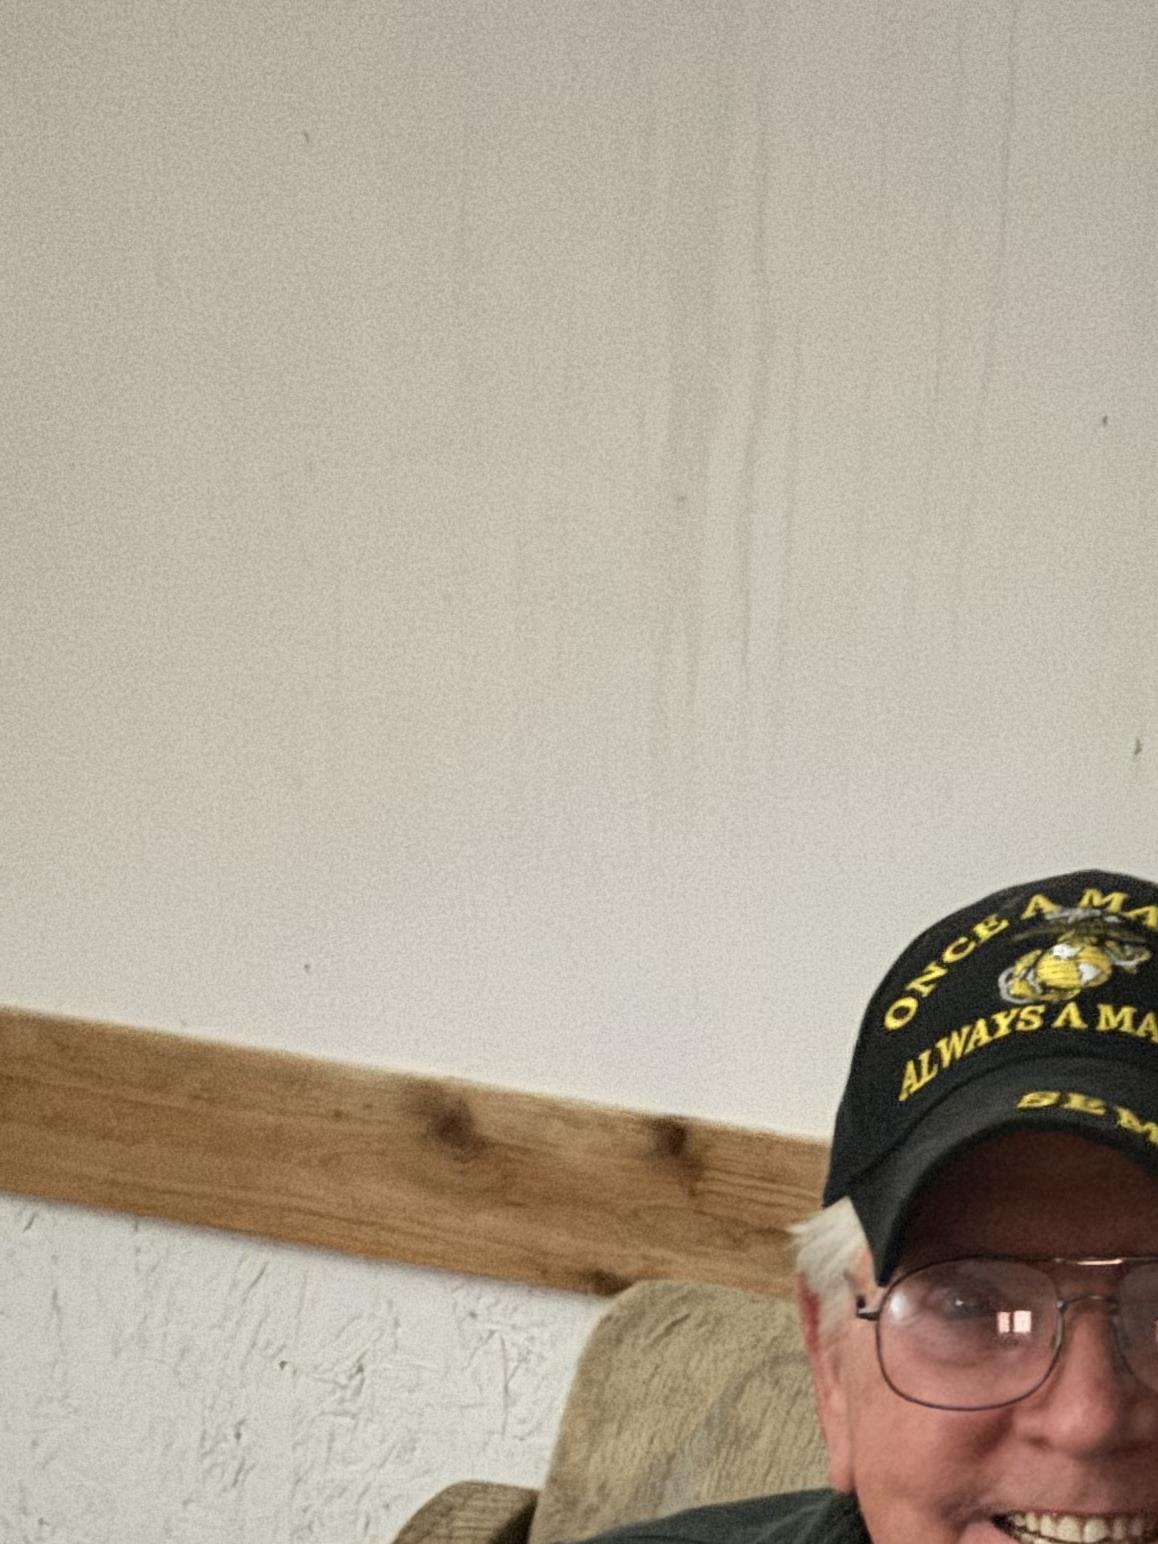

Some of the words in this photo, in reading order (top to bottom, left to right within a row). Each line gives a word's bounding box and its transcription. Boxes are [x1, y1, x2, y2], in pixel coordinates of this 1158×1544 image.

[883, 915, 1010, 1031] ONCE
[1021, 893, 1061, 920] A
[898, 1003, 1046, 1102] ALWAYS
[1051, 1002, 1087, 1030] A
